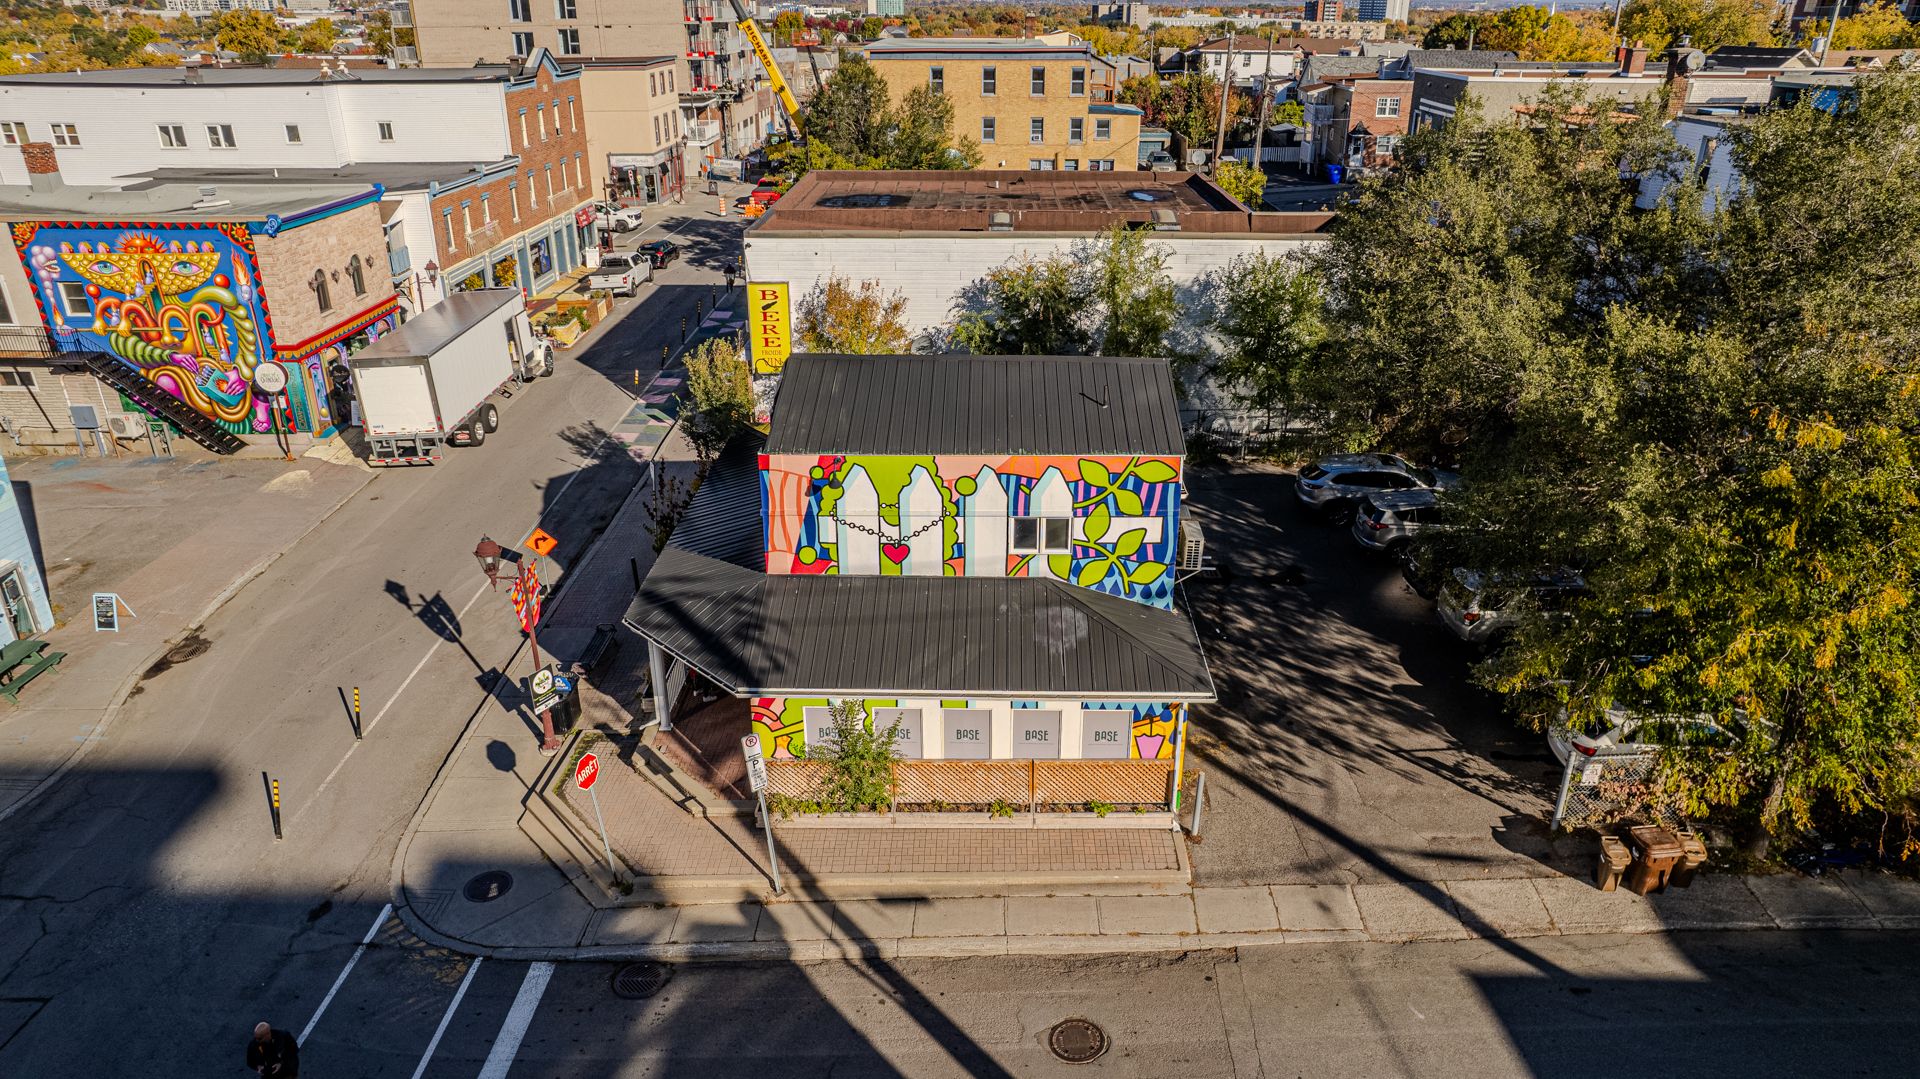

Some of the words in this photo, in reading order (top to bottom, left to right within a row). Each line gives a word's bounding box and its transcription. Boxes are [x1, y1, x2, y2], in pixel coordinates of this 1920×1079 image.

[746, 25, 772, 67] RICHARD
[764, 357, 783, 367] VIN
[818, 727, 842, 739] BAS
[888, 728, 911, 740] ASE
[956, 729, 980, 741] BASE
[1025, 730, 1049, 742] BASE
[1094, 730, 1119, 742] BASE
[577, 758, 598, 785] ARRÊT
